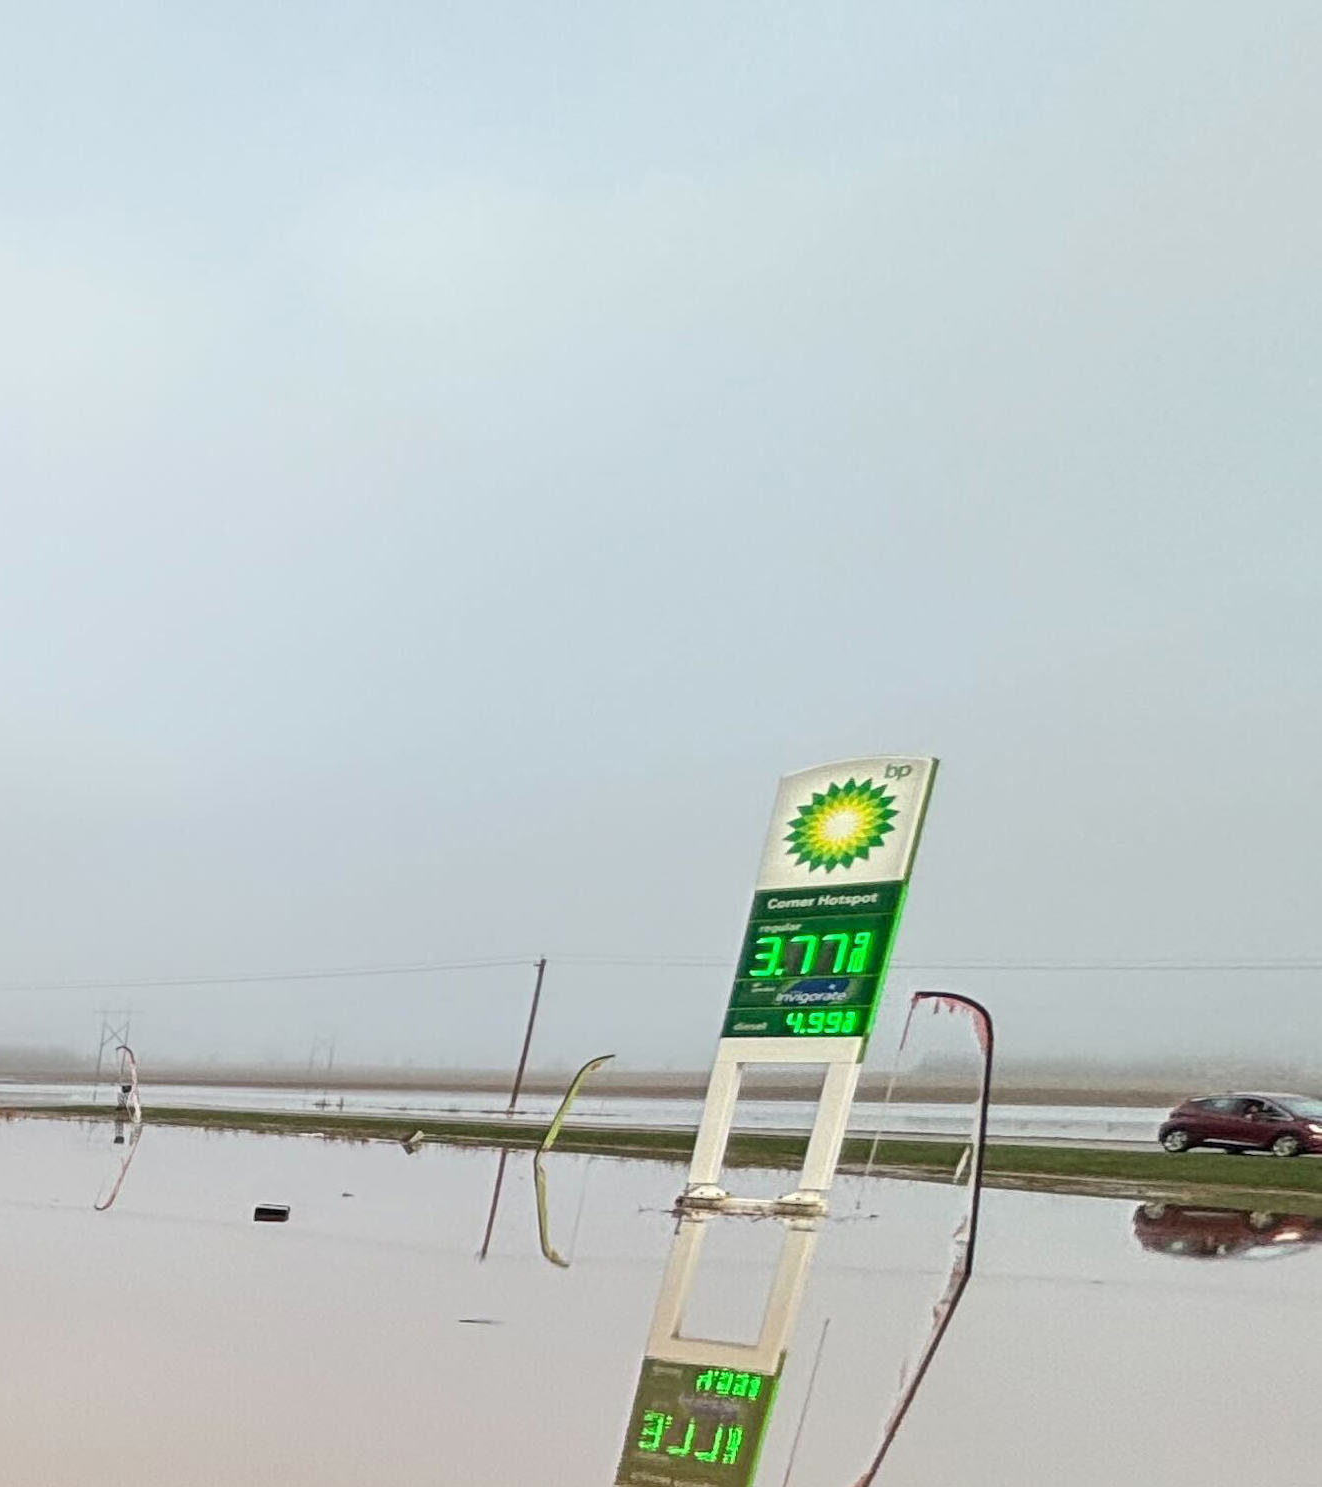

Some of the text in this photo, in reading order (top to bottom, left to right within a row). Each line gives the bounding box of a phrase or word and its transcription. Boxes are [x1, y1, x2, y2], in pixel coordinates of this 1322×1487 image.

[884, 764, 912, 781] bp
[817, 893, 879, 906] Hotspot
[758, 923, 802, 933] regular
